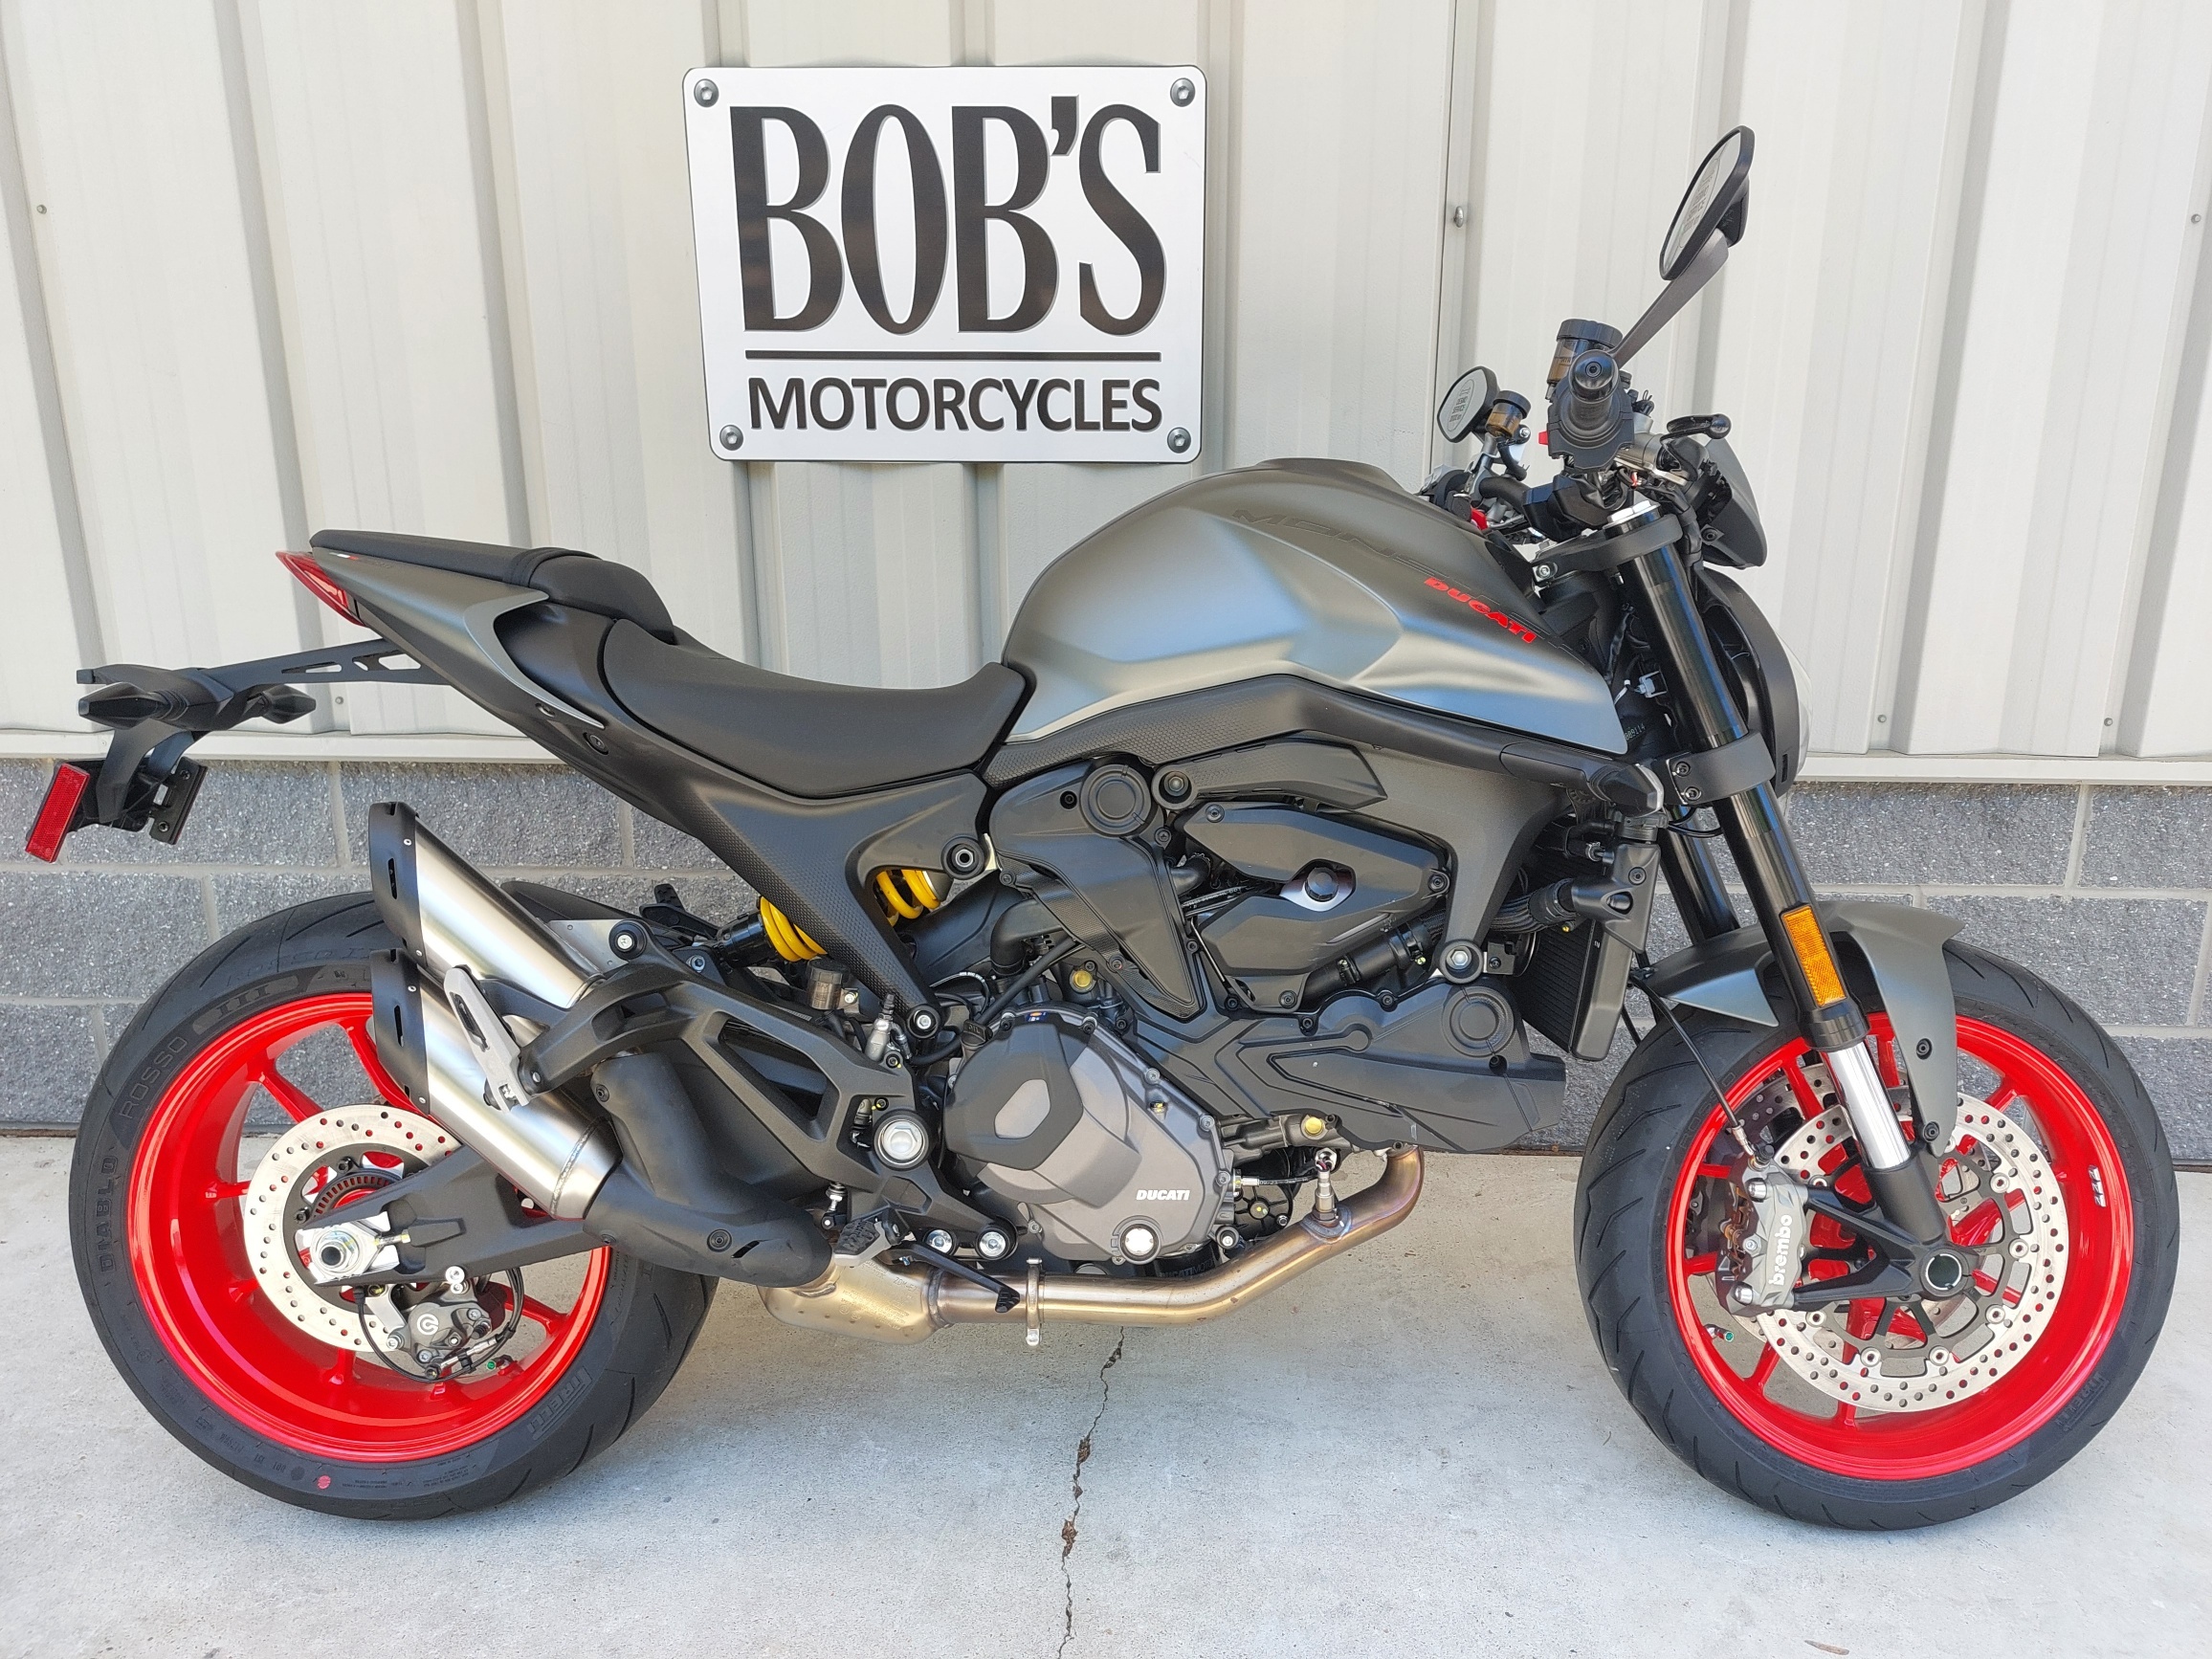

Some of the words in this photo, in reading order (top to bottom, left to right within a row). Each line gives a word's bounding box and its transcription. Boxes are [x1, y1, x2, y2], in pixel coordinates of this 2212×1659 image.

[729, 95, 1166, 336] BOB'S
[748, 376, 1162, 433] MOTORCYCLES
[1424, 578, 1537, 643] DUCATI
[97, 1154, 119, 1271] DIABLO
[121, 1034, 189, 1120] ROSSO
[1136, 1189, 1190, 1201] DUCATI
[1767, 1213, 1794, 1289] brembo
[526, 1365, 592, 1441] PIRELLI
